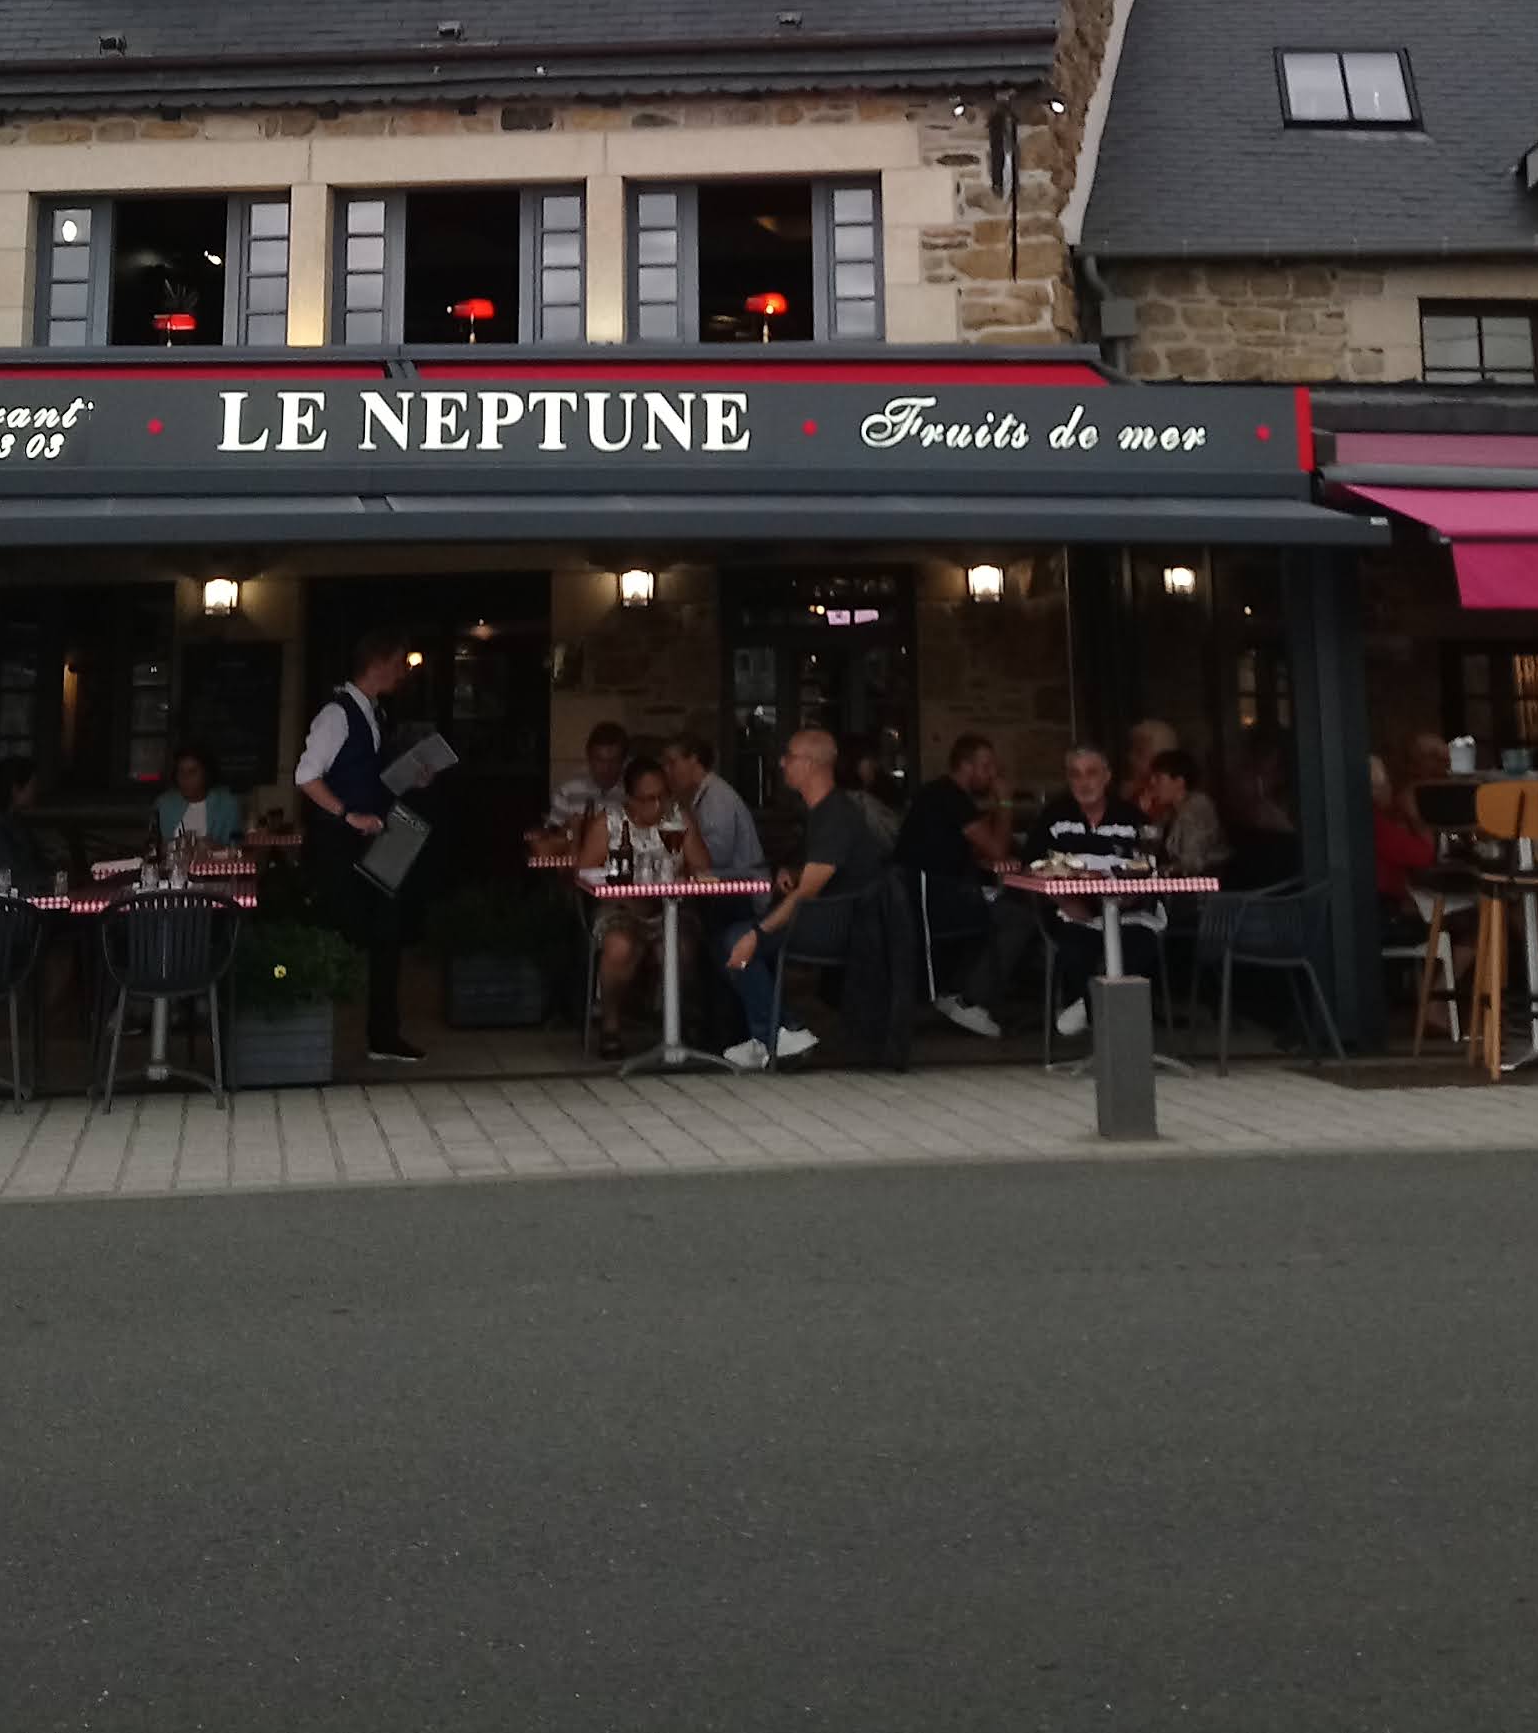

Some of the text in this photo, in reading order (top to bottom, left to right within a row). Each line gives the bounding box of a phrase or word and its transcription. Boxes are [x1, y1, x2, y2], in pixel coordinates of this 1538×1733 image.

[25, 433, 65, 458] 03
[217, 391, 751, 452] LE NEPTUNE
[861, 396, 1207, 451] Fruits de mer
